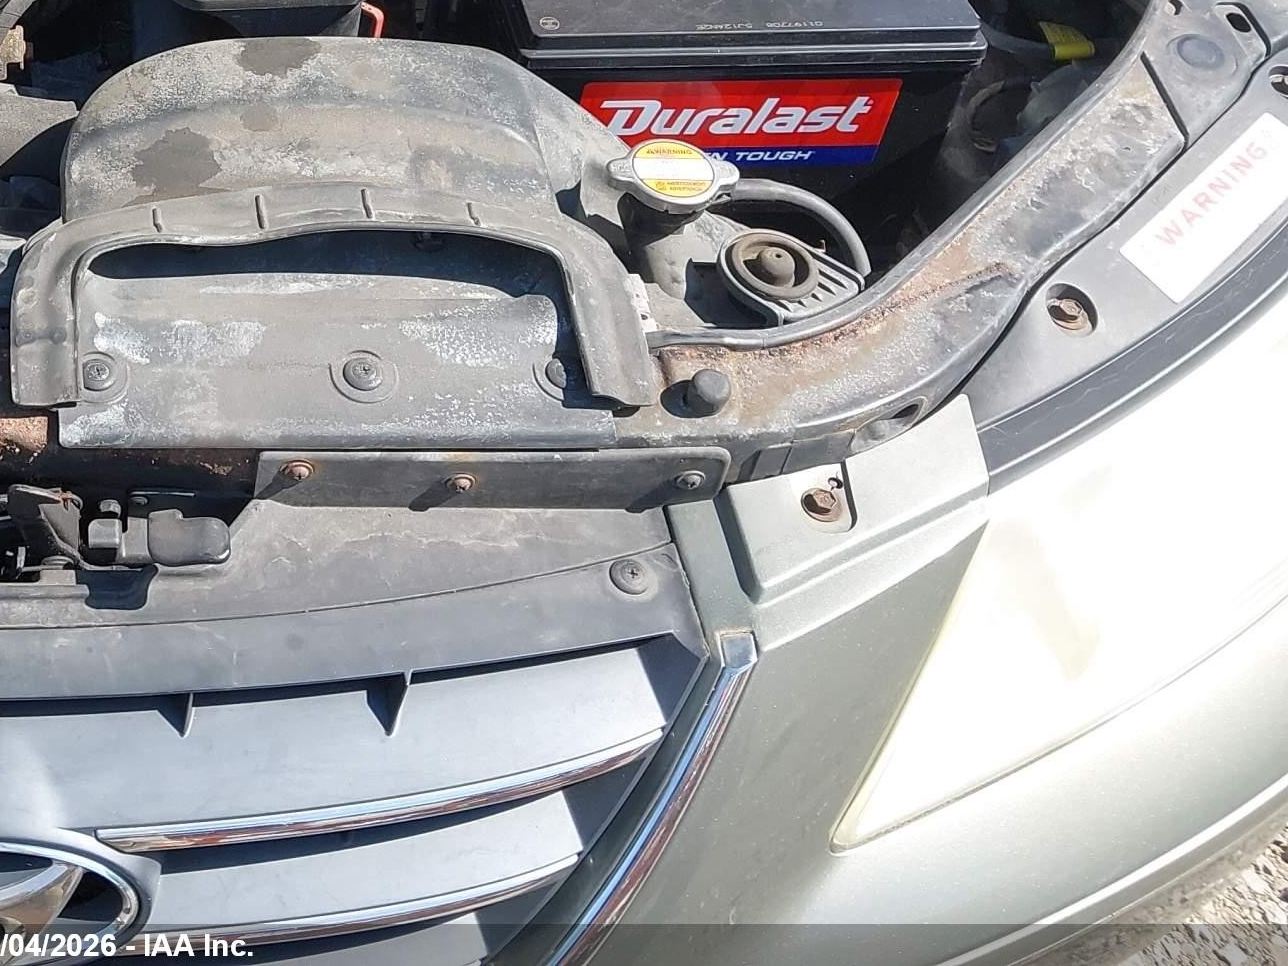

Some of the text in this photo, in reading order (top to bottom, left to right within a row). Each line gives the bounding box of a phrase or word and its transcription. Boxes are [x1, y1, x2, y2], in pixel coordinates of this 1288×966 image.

[600, 96, 874, 136] Duralast
[735, 150, 811, 161] TOUGH
[1156, 142, 1267, 246] WARNING
